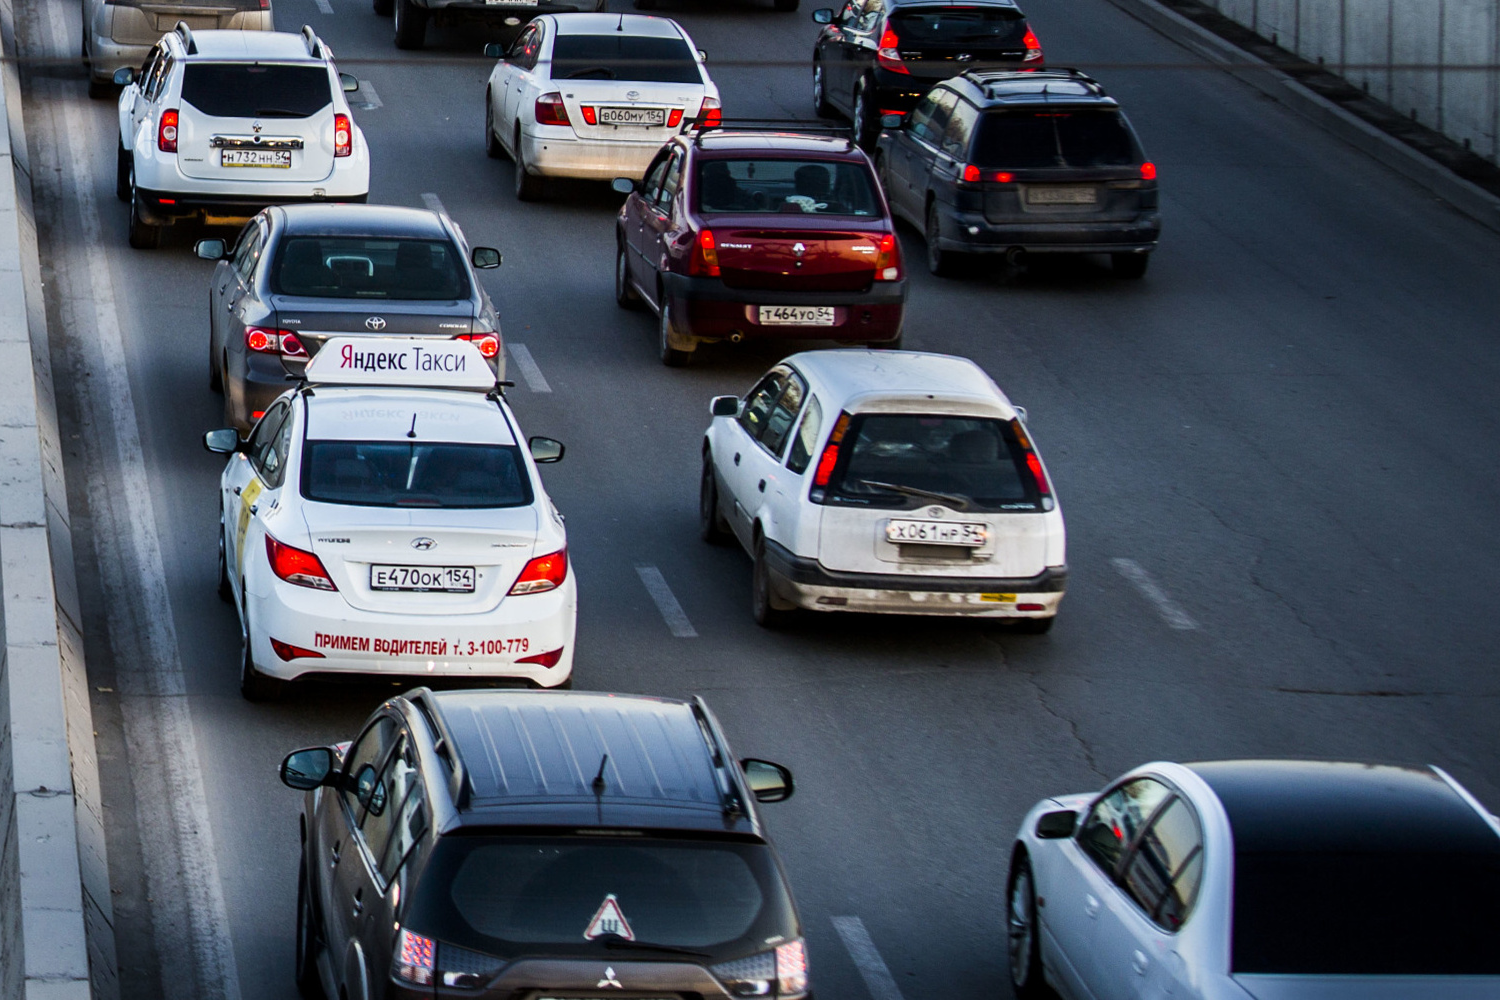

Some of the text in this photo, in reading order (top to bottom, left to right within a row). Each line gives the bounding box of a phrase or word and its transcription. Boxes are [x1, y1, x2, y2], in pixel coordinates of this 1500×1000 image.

[603, 110, 662, 121] В060МУ 154
[227, 151, 288, 163] Н732НН 54
[765, 307, 830, 321] Т464УО 54
[340, 344, 466, 372] Яндекс Такси
[896, 524, 980, 540] Х061НР 54
[377, 569, 470, 586] Е470ОК 154
[315, 632, 370, 652] ПРИМЕМ
[373, 638, 447, 656] ВОДИТЕЛЕЙ
[467, 637, 530, 656] 3-100-779
